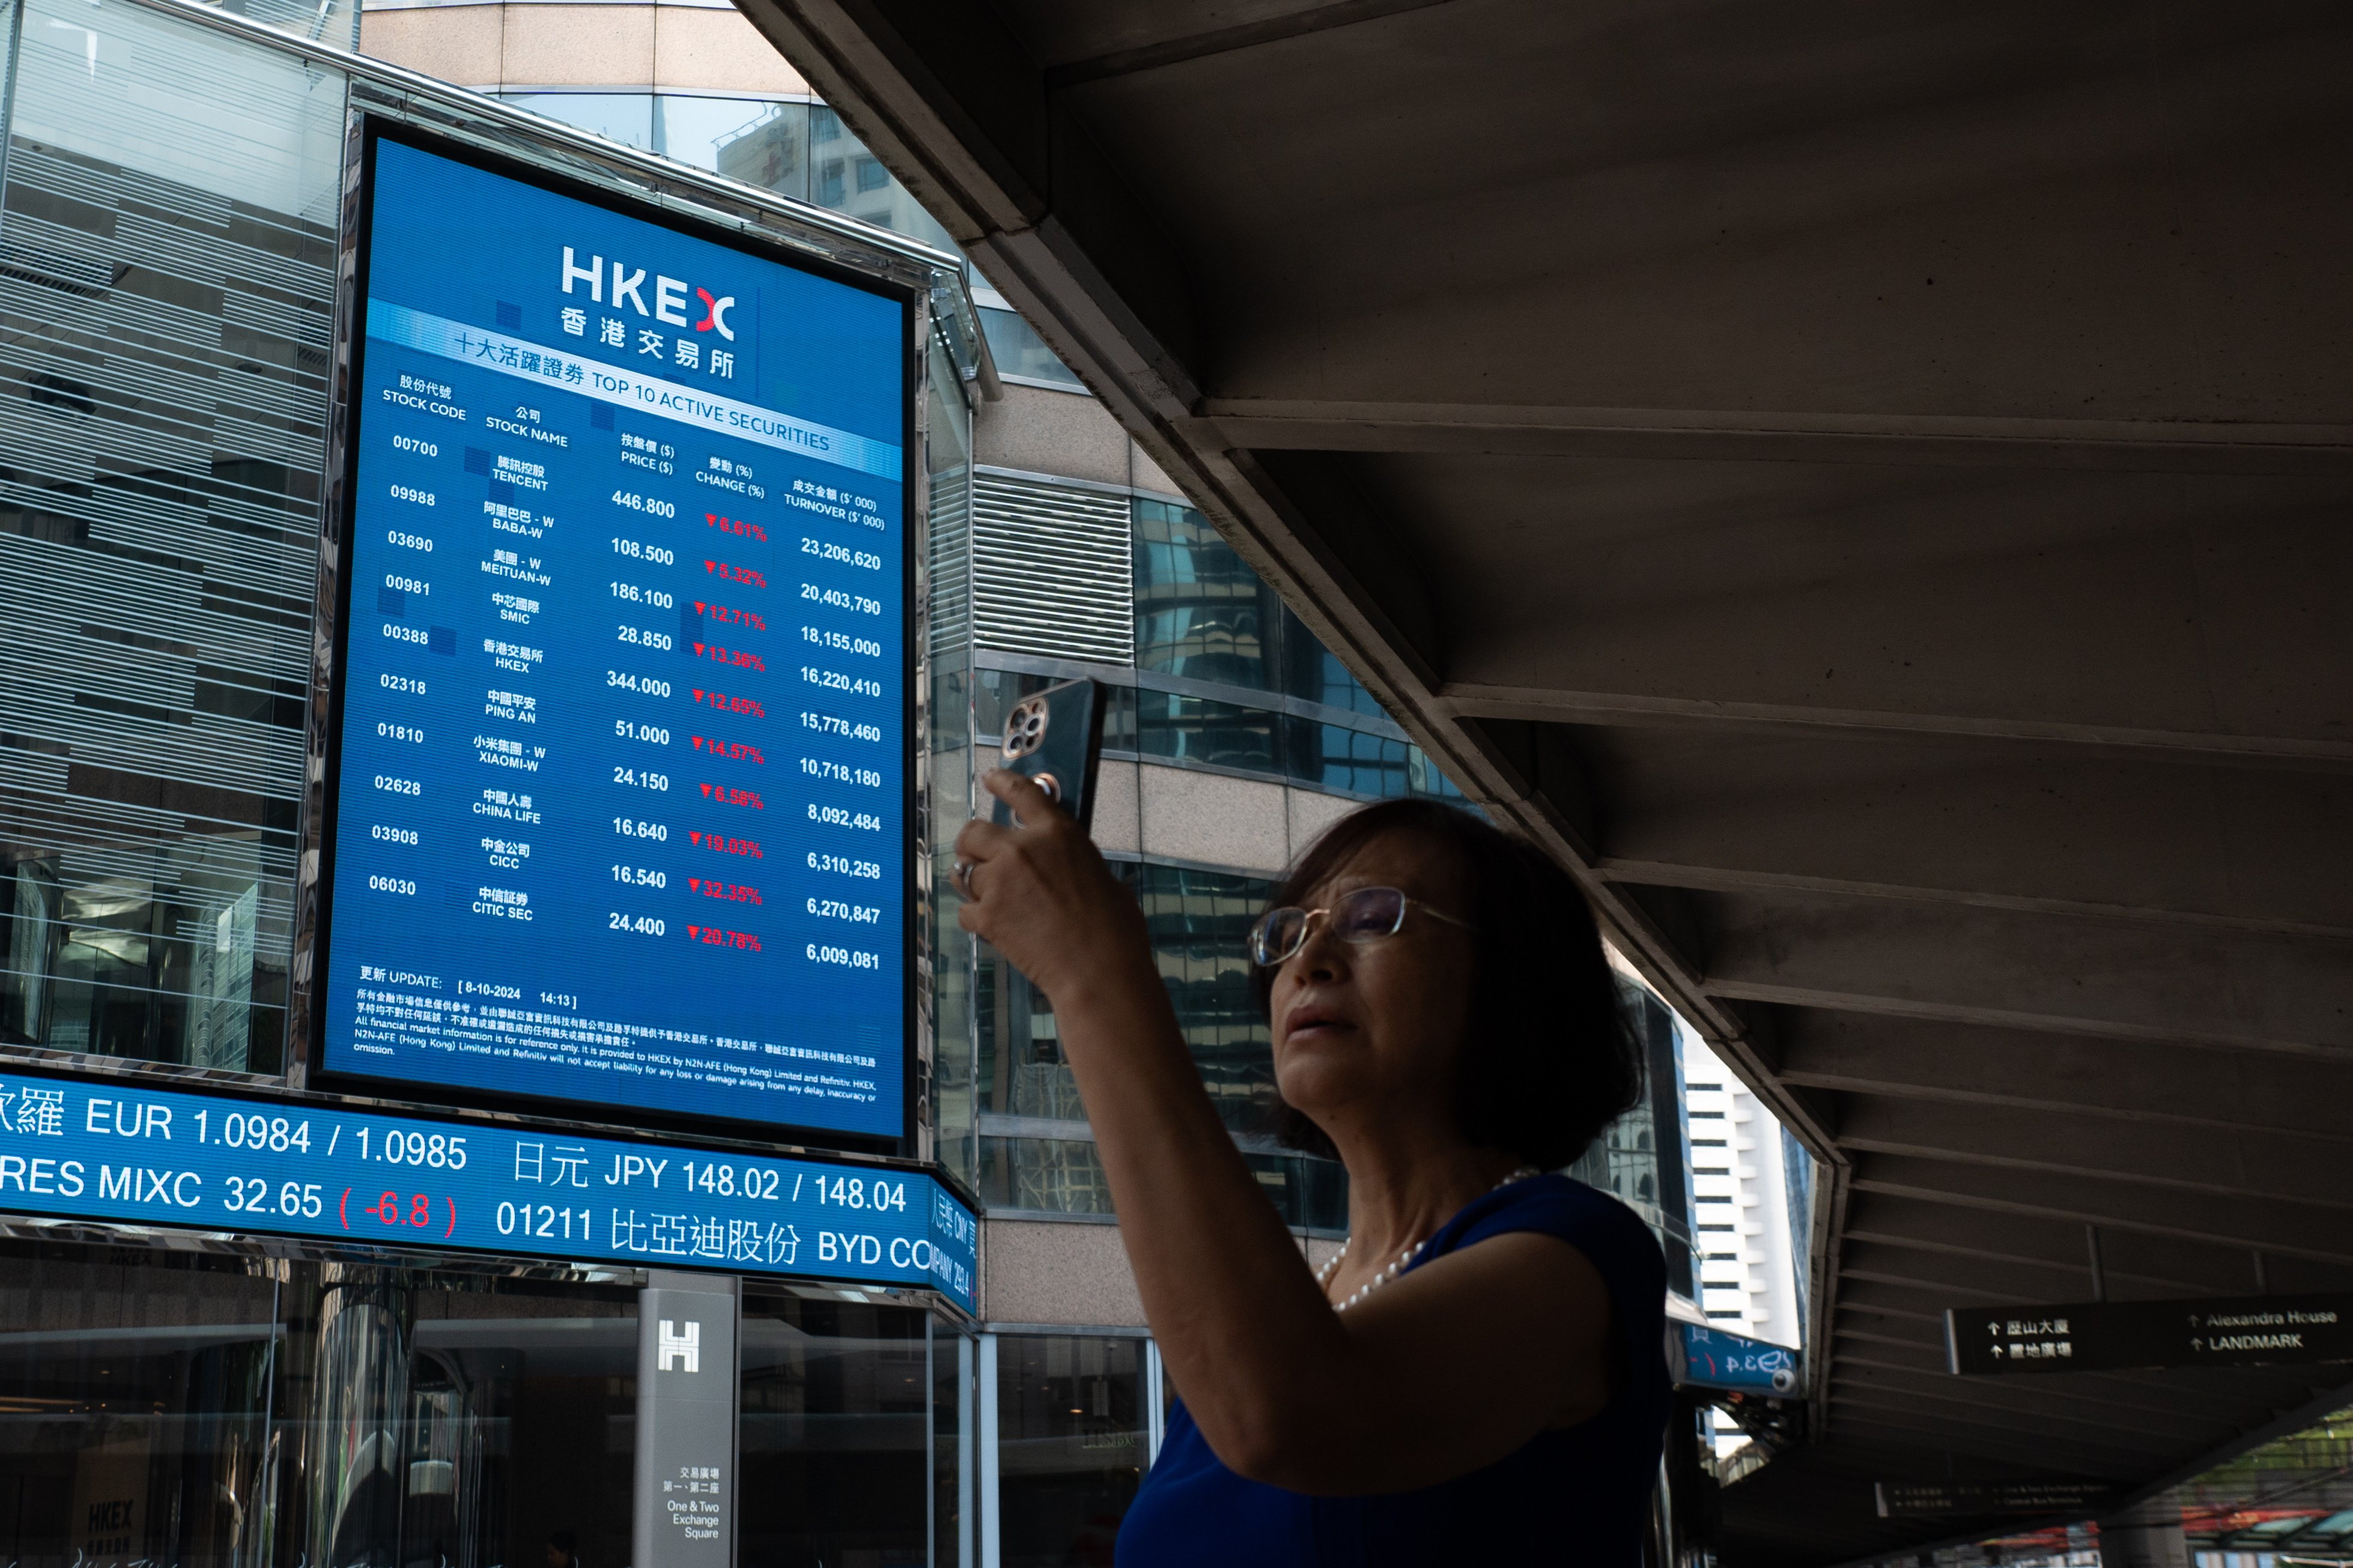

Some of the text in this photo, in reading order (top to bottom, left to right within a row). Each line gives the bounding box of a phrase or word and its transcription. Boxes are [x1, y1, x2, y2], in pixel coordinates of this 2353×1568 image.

[562, 246, 735, 341] HKEX
[561, 307, 733, 379] 香港交易所
[399, 374, 452, 400] 股份代號
[383, 389, 466, 420] STOCK CODE
[515, 406, 540, 423] 公司
[592, 372, 629, 394] TOP
[635, 385, 655, 402] 10
[659, 392, 724, 422] ACTIVE
[728, 410, 830, 452] SECURITIES
[486, 417, 568, 447] STOCK NAME
[393, 435, 438, 457] 00700
[621, 451, 656, 470] PRICE
[735, 464, 752, 479] (%)
[492, 468, 548, 491] TENCENT
[696, 471, 764, 499] CHANGE (%)
[793, 479, 837, 501] 成交金額
[390, 484, 435, 506] 09988
[612, 490, 675, 518] 446.800
[784, 494, 845, 519] TURNOVER
[484, 501, 531, 523] 阿里巴巴
[542, 515, 554, 528] W
[387, 530, 433, 552] 03690
[493, 518, 542, 539] BABA-W
[719, 516, 767, 542] 6.61%
[493, 549, 518, 566] 美團
[529, 557, 541, 570] W
[612, 537, 673, 566] 108.500
[801, 537, 881, 571] 23,206,620
[386, 574, 430, 596] 00981
[481, 560, 551, 586] MEITUAN-W
[719, 563, 767, 589] 5.32%
[491, 592, 539, 614] 中芯國際
[610, 581, 673, 609] 186.100
[801, 583, 881, 616] 20,403,790
[500, 609, 529, 625] SMIC
[709, 605, 765, 631] 12.71%
[383, 623, 428, 645] 00388
[618, 625, 672, 650] 28.850
[801, 626, 880, 657] 18,155,000
[483, 638, 543, 663] 香港交易所
[709, 646, 765, 672] 13.36%
[495, 656, 529, 673] HKEX
[380, 674, 426, 695] 02318
[607, 670, 670, 698] 344.000
[801, 666, 880, 697] 16,220,410
[488, 689, 536, 711] 中國平安
[708, 692, 765, 718] 12.65%
[485, 704, 535, 724] PING AN
[378, 722, 424, 743] 01810
[615, 719, 669, 745] 51.000
[800, 712, 881, 742] 15,778,460
[473, 735, 522, 756] 小米集團
[533, 746, 546, 758] W
[707, 739, 764, 764] 14.57%
[479, 751, 538, 772] XIAOMI-W
[800, 757, 881, 787] 10,718,180
[375, 775, 421, 796] 02628
[613, 766, 669, 792] 24.150
[483, 789, 532, 810] 中國人壽
[714, 786, 764, 810] 6.58%
[473, 802, 541, 824] CHINA LIFE
[807, 804, 881, 832] 8,092,484
[372, 825, 418, 845] 03908
[613, 817, 667, 841] 16.640
[481, 837, 530, 858] 中金公司
[705, 834, 763, 859] 19.03%
[490, 854, 519, 869] CICC
[807, 852, 880, 879] 6,310,258
[369, 875, 416, 895] 06030
[612, 864, 666, 888] 16.540
[703, 880, 762, 905] 32.35%
[472, 901, 533, 921] CITIC SEC
[807, 898, 881, 924] 6,270,847
[609, 912, 665, 936] 24.400
[702, 927, 761, 952] 20.78%
[806, 943, 878, 970] 6,009,081
[360, 965, 386, 982] 更新
[389, 971, 442, 988] UPDATE:
[465, 981, 521, 1000] 8-10-2024
[539, 991, 569, 1006] 14:13
[354, 1016, 579, 1055] All financial market information is for reference only.
[87, 1099, 172, 1139] EUR
[195, 1110, 311, 1153] 1.0984
[328, 1125, 341, 1155] /
[357, 1127, 466, 1169] 1.0985
[515, 1142, 589, 1187] 日元
[605, 1155, 667, 1187] JPY
[684, 1162, 779, 1199] 148.02
[793, 1174, 802, 1201] /
[816, 1176, 906, 1211] 148.04
[0, 1155, 85, 1197] RES
[99, 1165, 201, 1206] MIXC
[224, 1177, 321, 1217] 32.65
[366, 1191, 429, 1227] -6.8
[497, 1202, 589, 1240] 01211
[613, 1208, 801, 1265] 比亞迪股份
[819, 1232, 881, 1264] BYD
[2207, 1310, 2337, 1327] Alexandra House
[2209, 1334, 2304, 1351] LANDMARK
[680, 1467, 720, 1480] 交易廣場
[667, 1500, 720, 1513] One & Two
[673, 1514, 719, 1527] Exchange
[685, 1527, 718, 1540] Square
